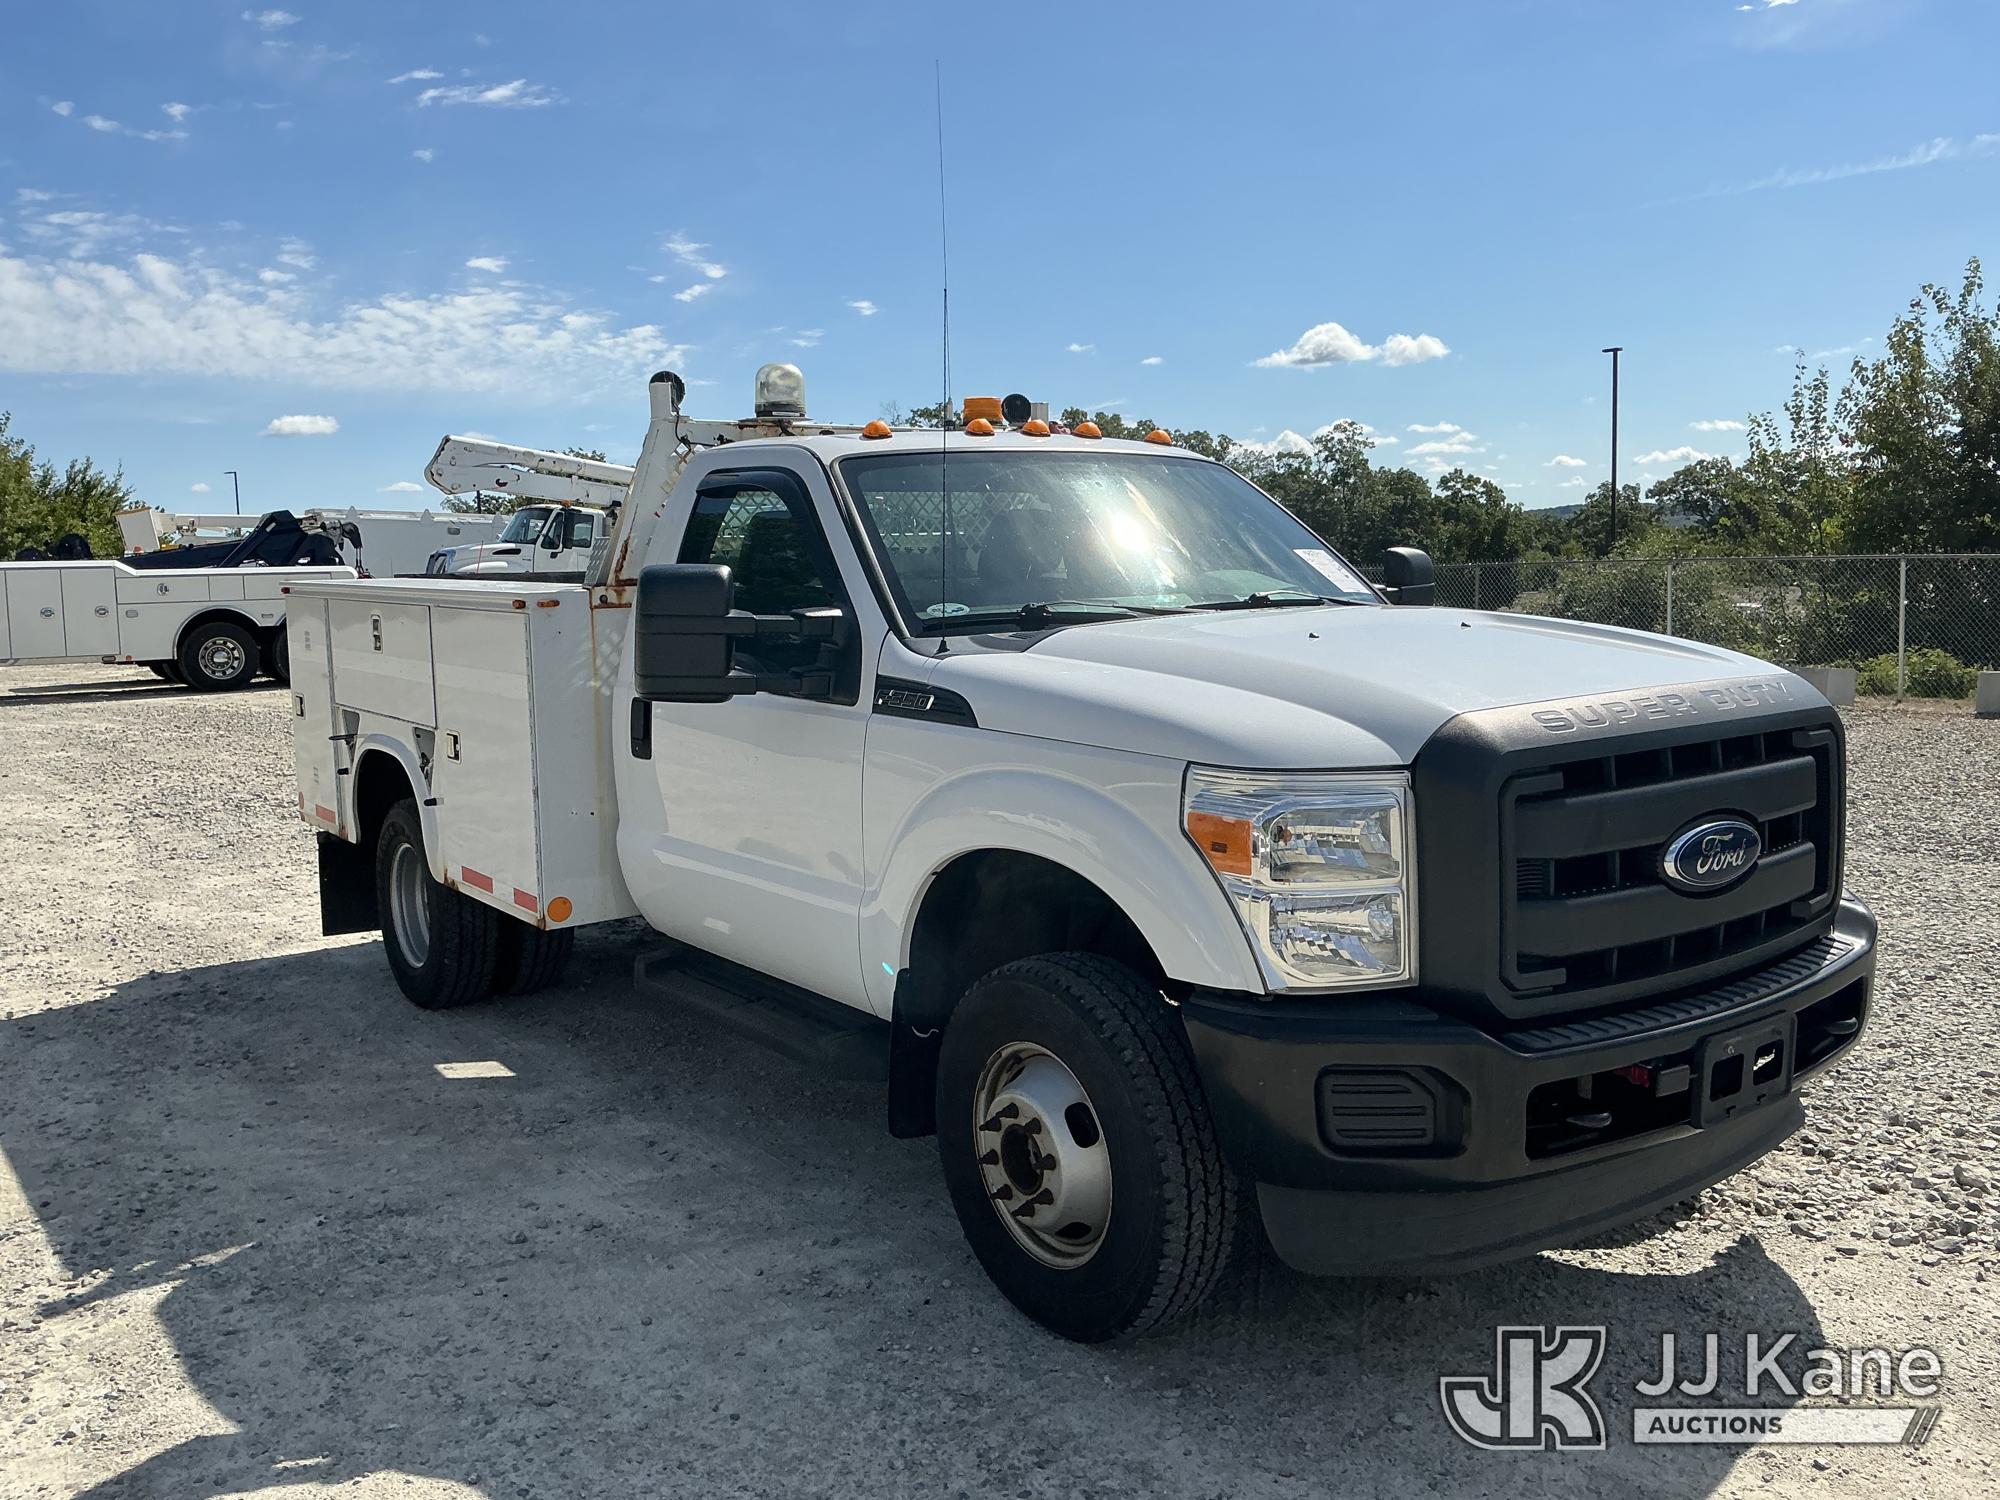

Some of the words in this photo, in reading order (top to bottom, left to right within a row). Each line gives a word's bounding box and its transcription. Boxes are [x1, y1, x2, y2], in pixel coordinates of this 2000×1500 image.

[1531, 693, 1699, 734] SUPER
[1699, 681, 1794, 711] DUTY
[1696, 832, 1746, 874] Ford
